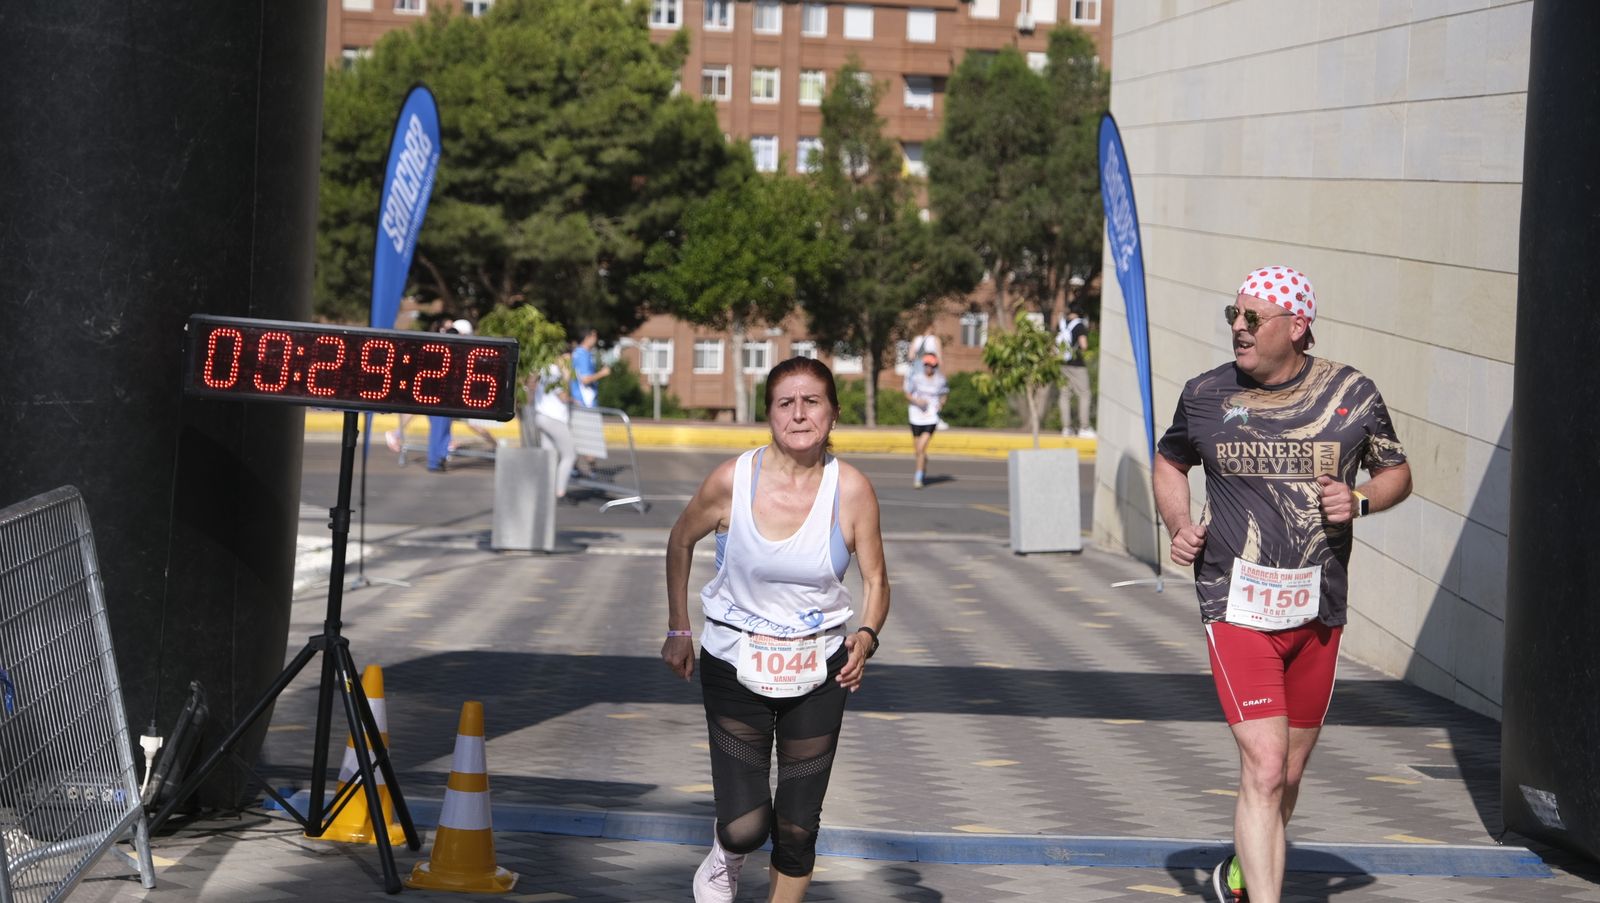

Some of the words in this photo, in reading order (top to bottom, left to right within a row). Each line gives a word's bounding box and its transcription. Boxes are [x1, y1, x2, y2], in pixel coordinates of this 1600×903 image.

[1216, 441, 1313, 459] RUNNERS
[1320, 444, 1335, 472] TEAM
[1217, 458, 1313, 474] FOREVER
[1242, 584, 1310, 609] 1150
[751, 651, 818, 674] 1044
[1242, 698, 1267, 707] CRAFT
